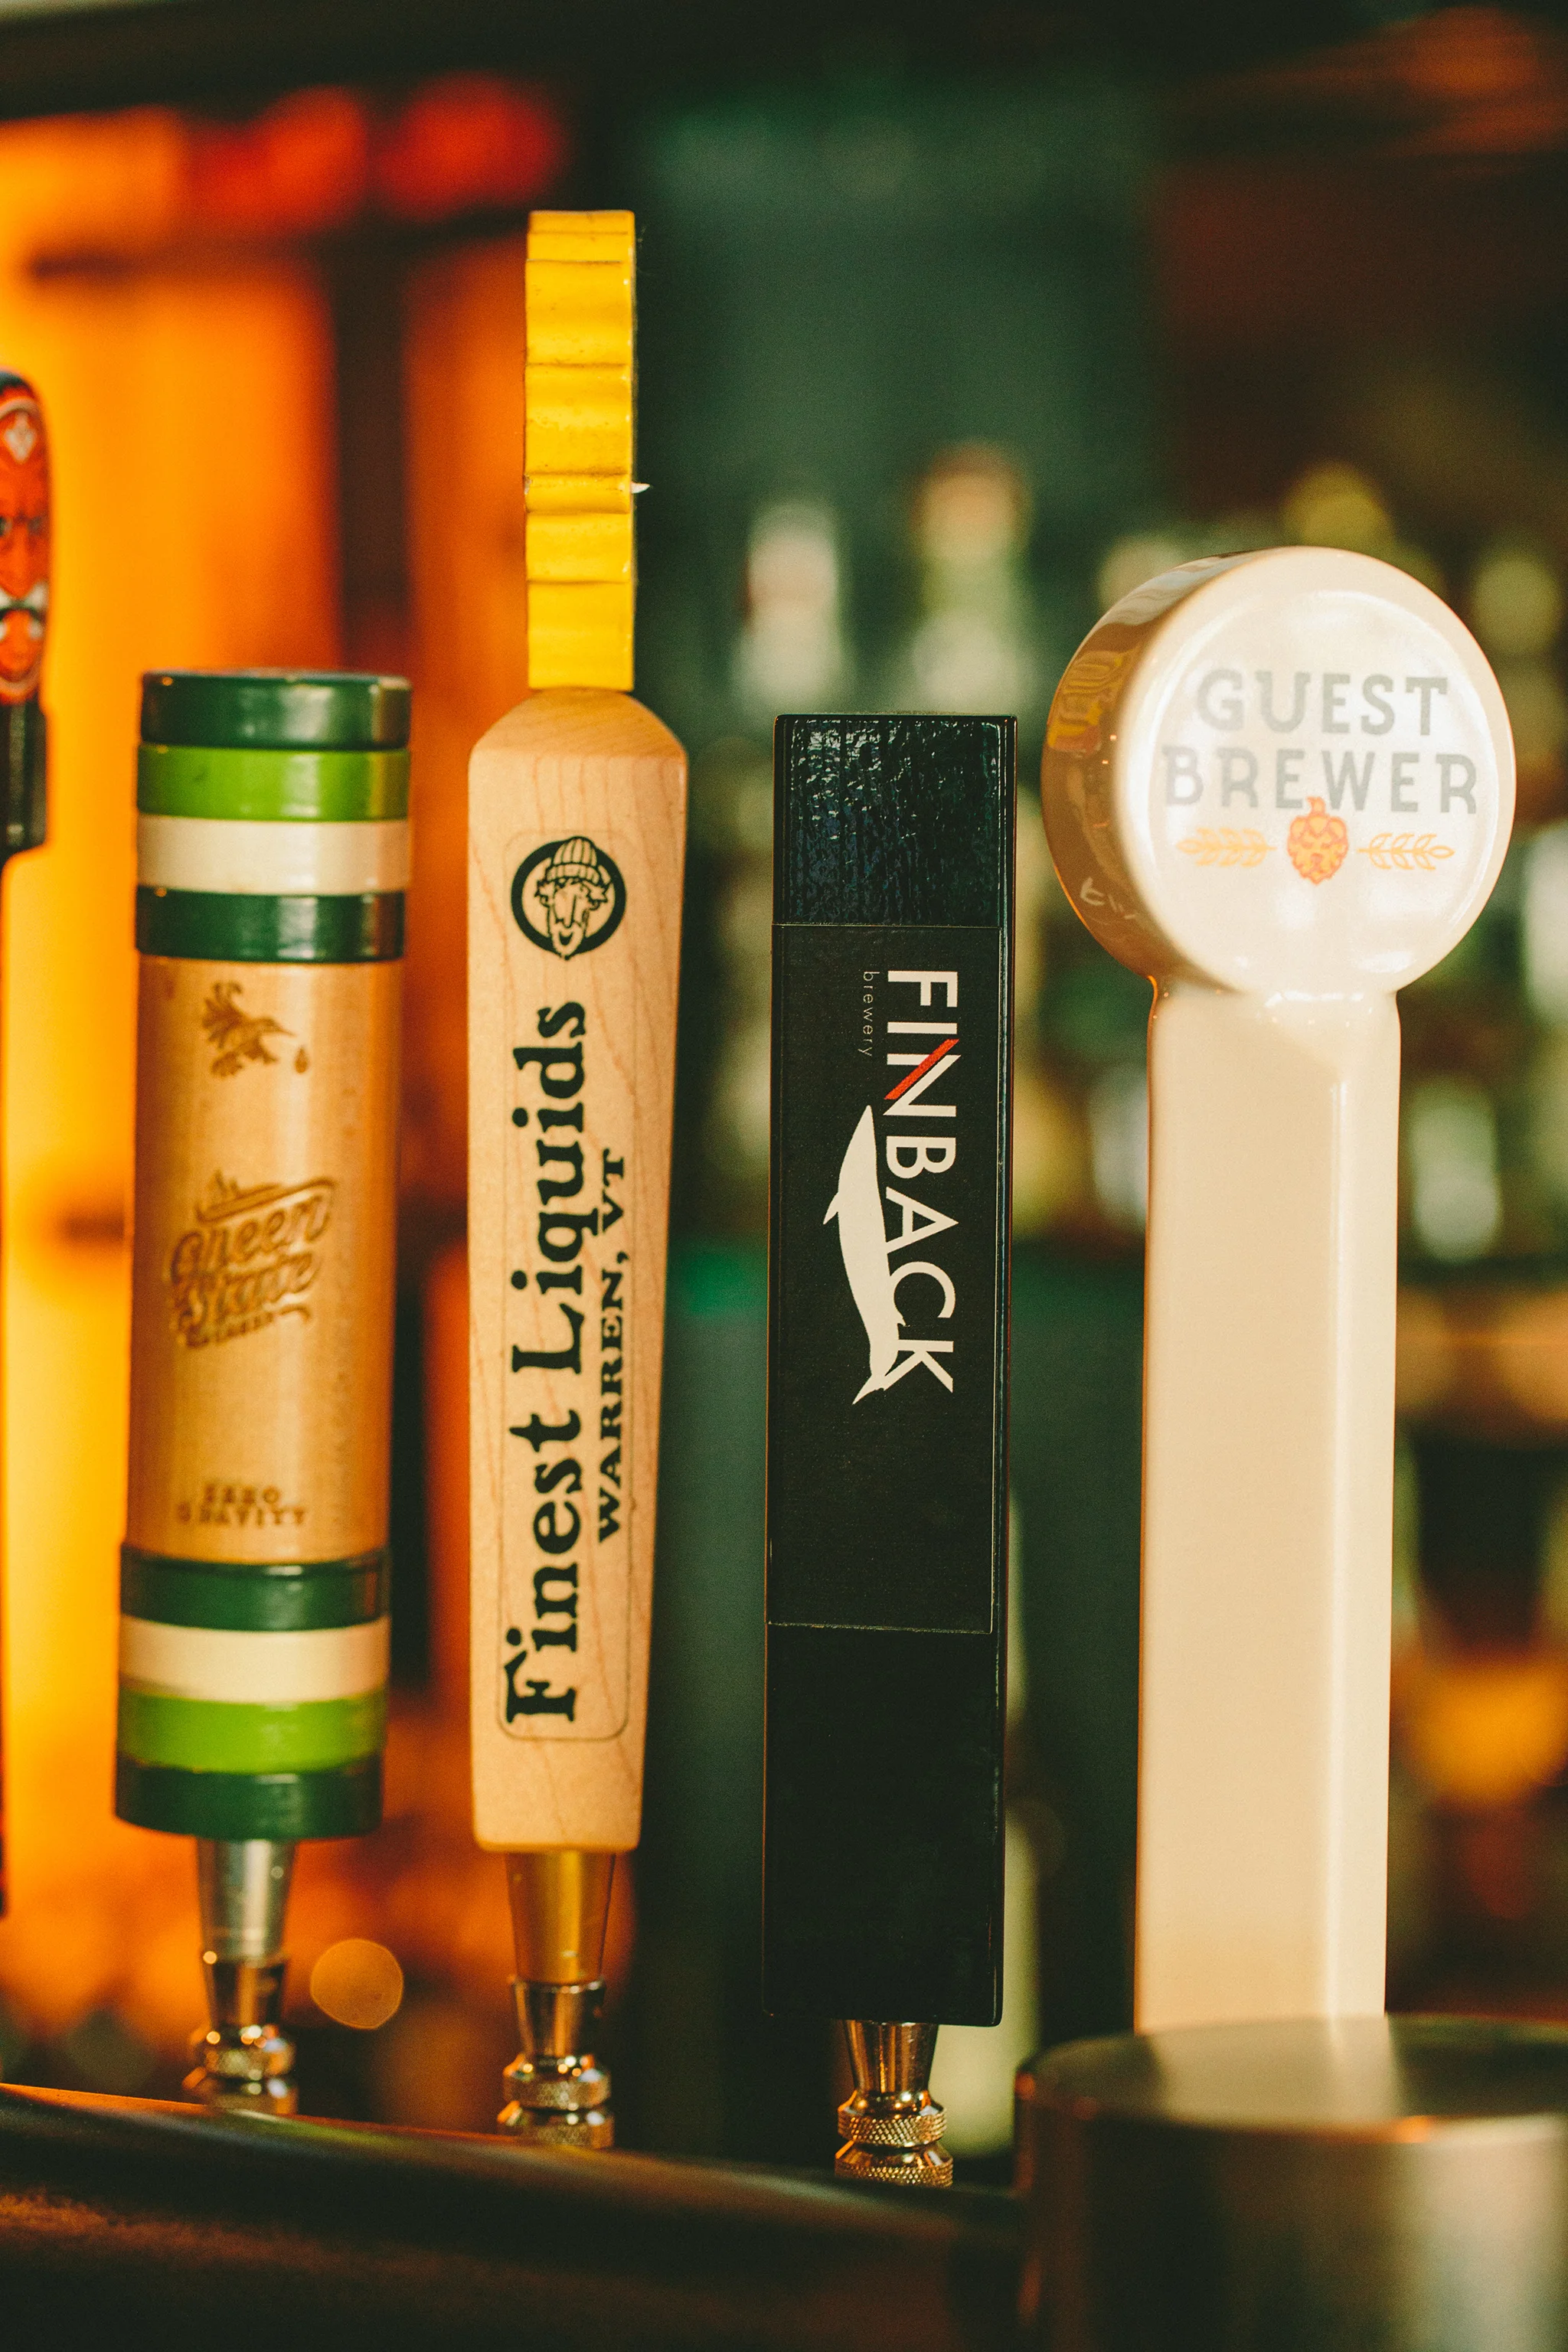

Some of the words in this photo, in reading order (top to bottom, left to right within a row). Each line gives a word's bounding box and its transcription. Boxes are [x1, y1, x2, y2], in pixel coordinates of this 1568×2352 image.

[1161, 743, 1478, 815] BREWER
[1197, 668, 1449, 737] GUEST
[858, 970, 880, 1057] brewery
[511, 1000, 599, 1375] Liquids
[602, 1148, 625, 1233] VT
[883, 970, 962, 1393] FINBACK
[598, 1251, 630, 1544] WARREN,
[502, 1408, 583, 1723] Finest
